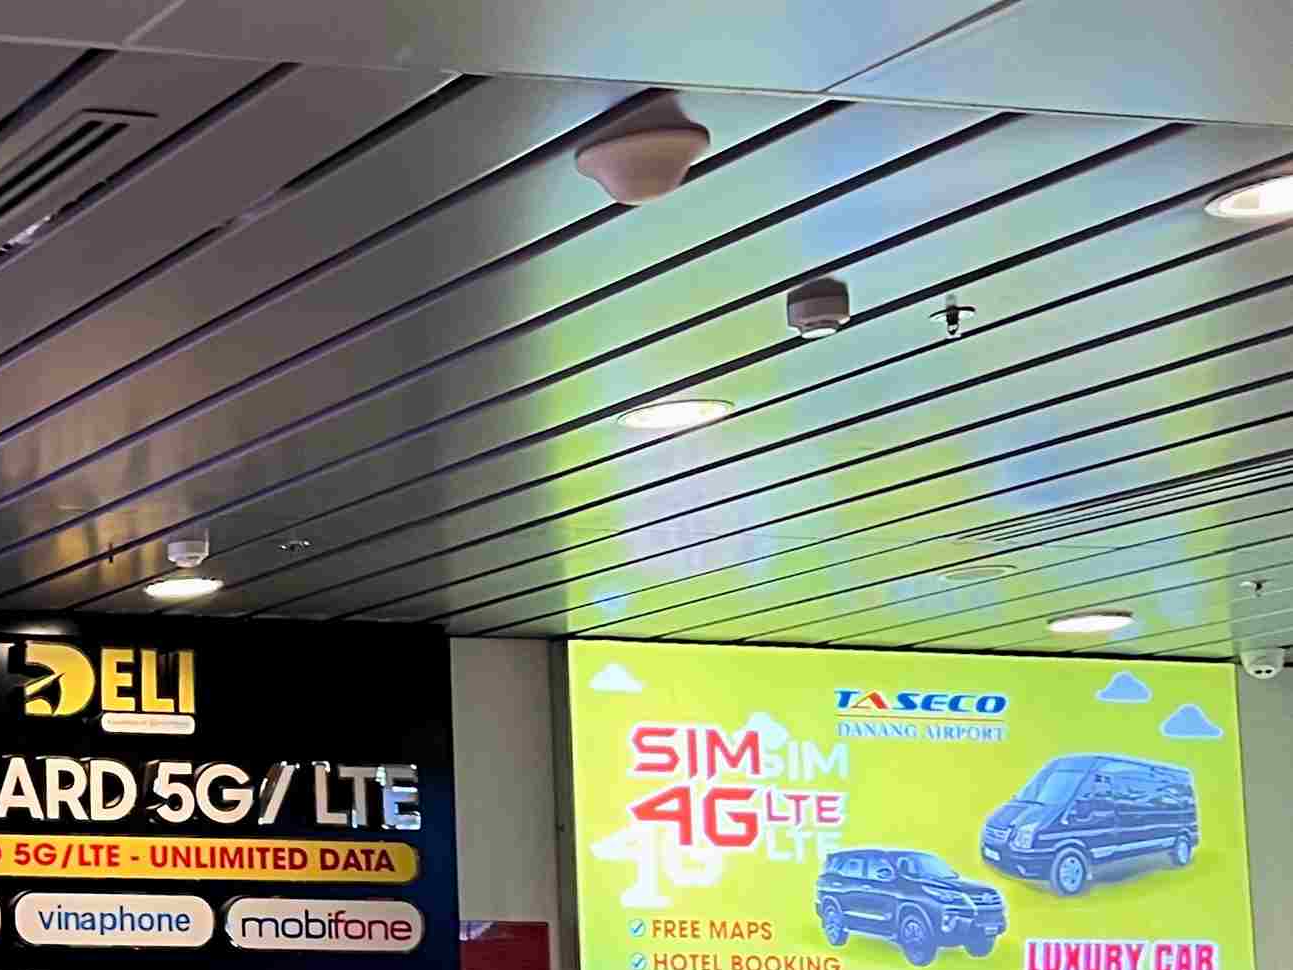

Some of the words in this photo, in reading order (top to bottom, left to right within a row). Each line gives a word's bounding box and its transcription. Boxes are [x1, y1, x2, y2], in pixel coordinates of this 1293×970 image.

[24, 640, 196, 716] DELI
[834, 690, 1007, 714] TASECO
[837, 722, 918, 738] DANANG
[922, 724, 1005, 741] AIRPORT
[632, 727, 761, 779] SIM
[313, 760, 421, 829] LTE
[630, 785, 759, 847] 4G
[766, 790, 842, 826] LTE
[13, 842, 121, 868] 5G/LTE
[149, 846, 307, 871] UNLIMITED
[319, 848, 395, 873] DATA
[37, 904, 191, 937] vinaphone
[240, 910, 413, 941] mobifone
[652, 919, 701, 939] FREE
[709, 920, 773, 941] MAPS
